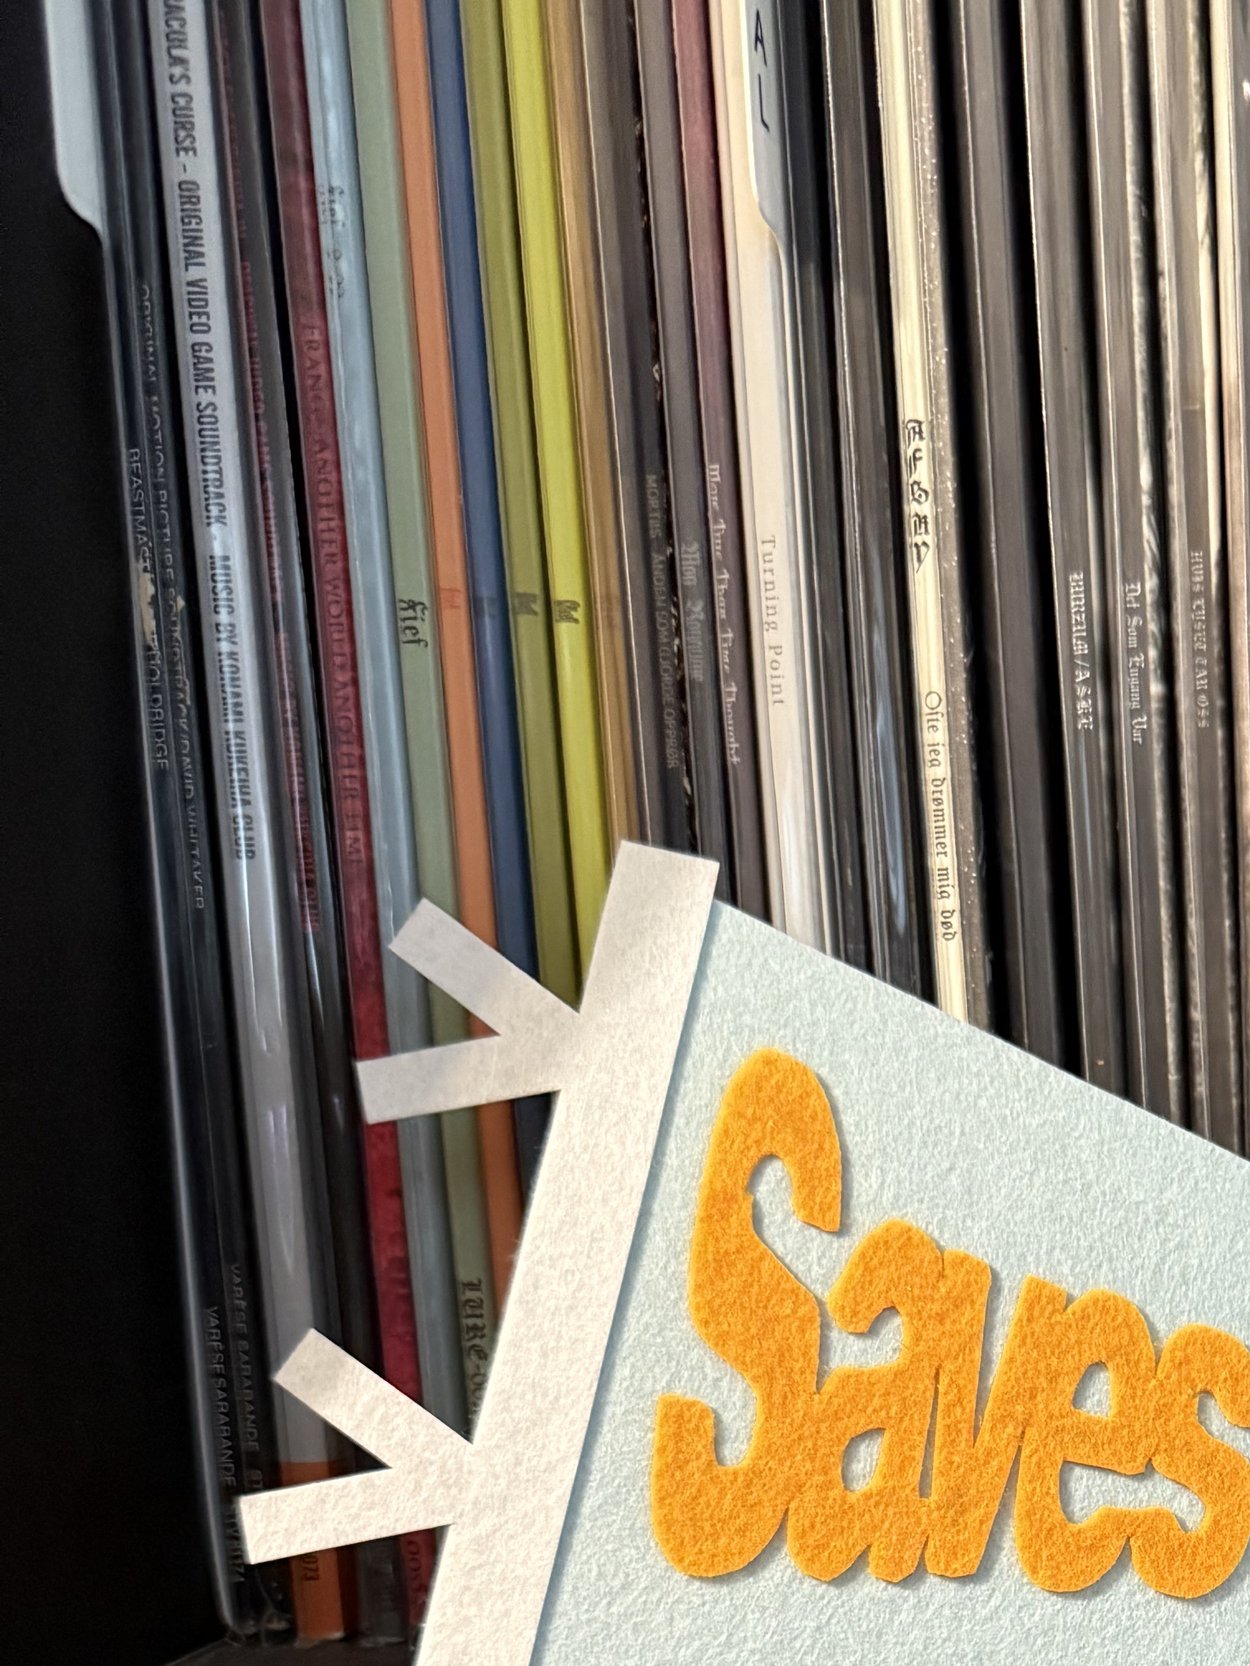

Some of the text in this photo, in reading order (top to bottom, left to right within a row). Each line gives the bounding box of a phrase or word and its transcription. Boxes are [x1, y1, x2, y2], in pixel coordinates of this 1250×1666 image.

[172, 92, 259, 860] CURSE ORIGINAL VIDEO GAME SOUNDTRACK MUSIC BY KONAMI KUKEIHA CLUB
[644, 474, 672, 642] MORTIIS SOM
[313, 438, 360, 800] ANOTHER WORLD ANOTHER
[398, 599, 432, 647] Fief
[759, 535, 787, 707] Turning Point
[1125, 581, 1149, 744] Det Som Engang Var
[1195, 657, 1210, 727] TAR OSS
[923, 691, 958, 942] Ofte drømmer mig død
